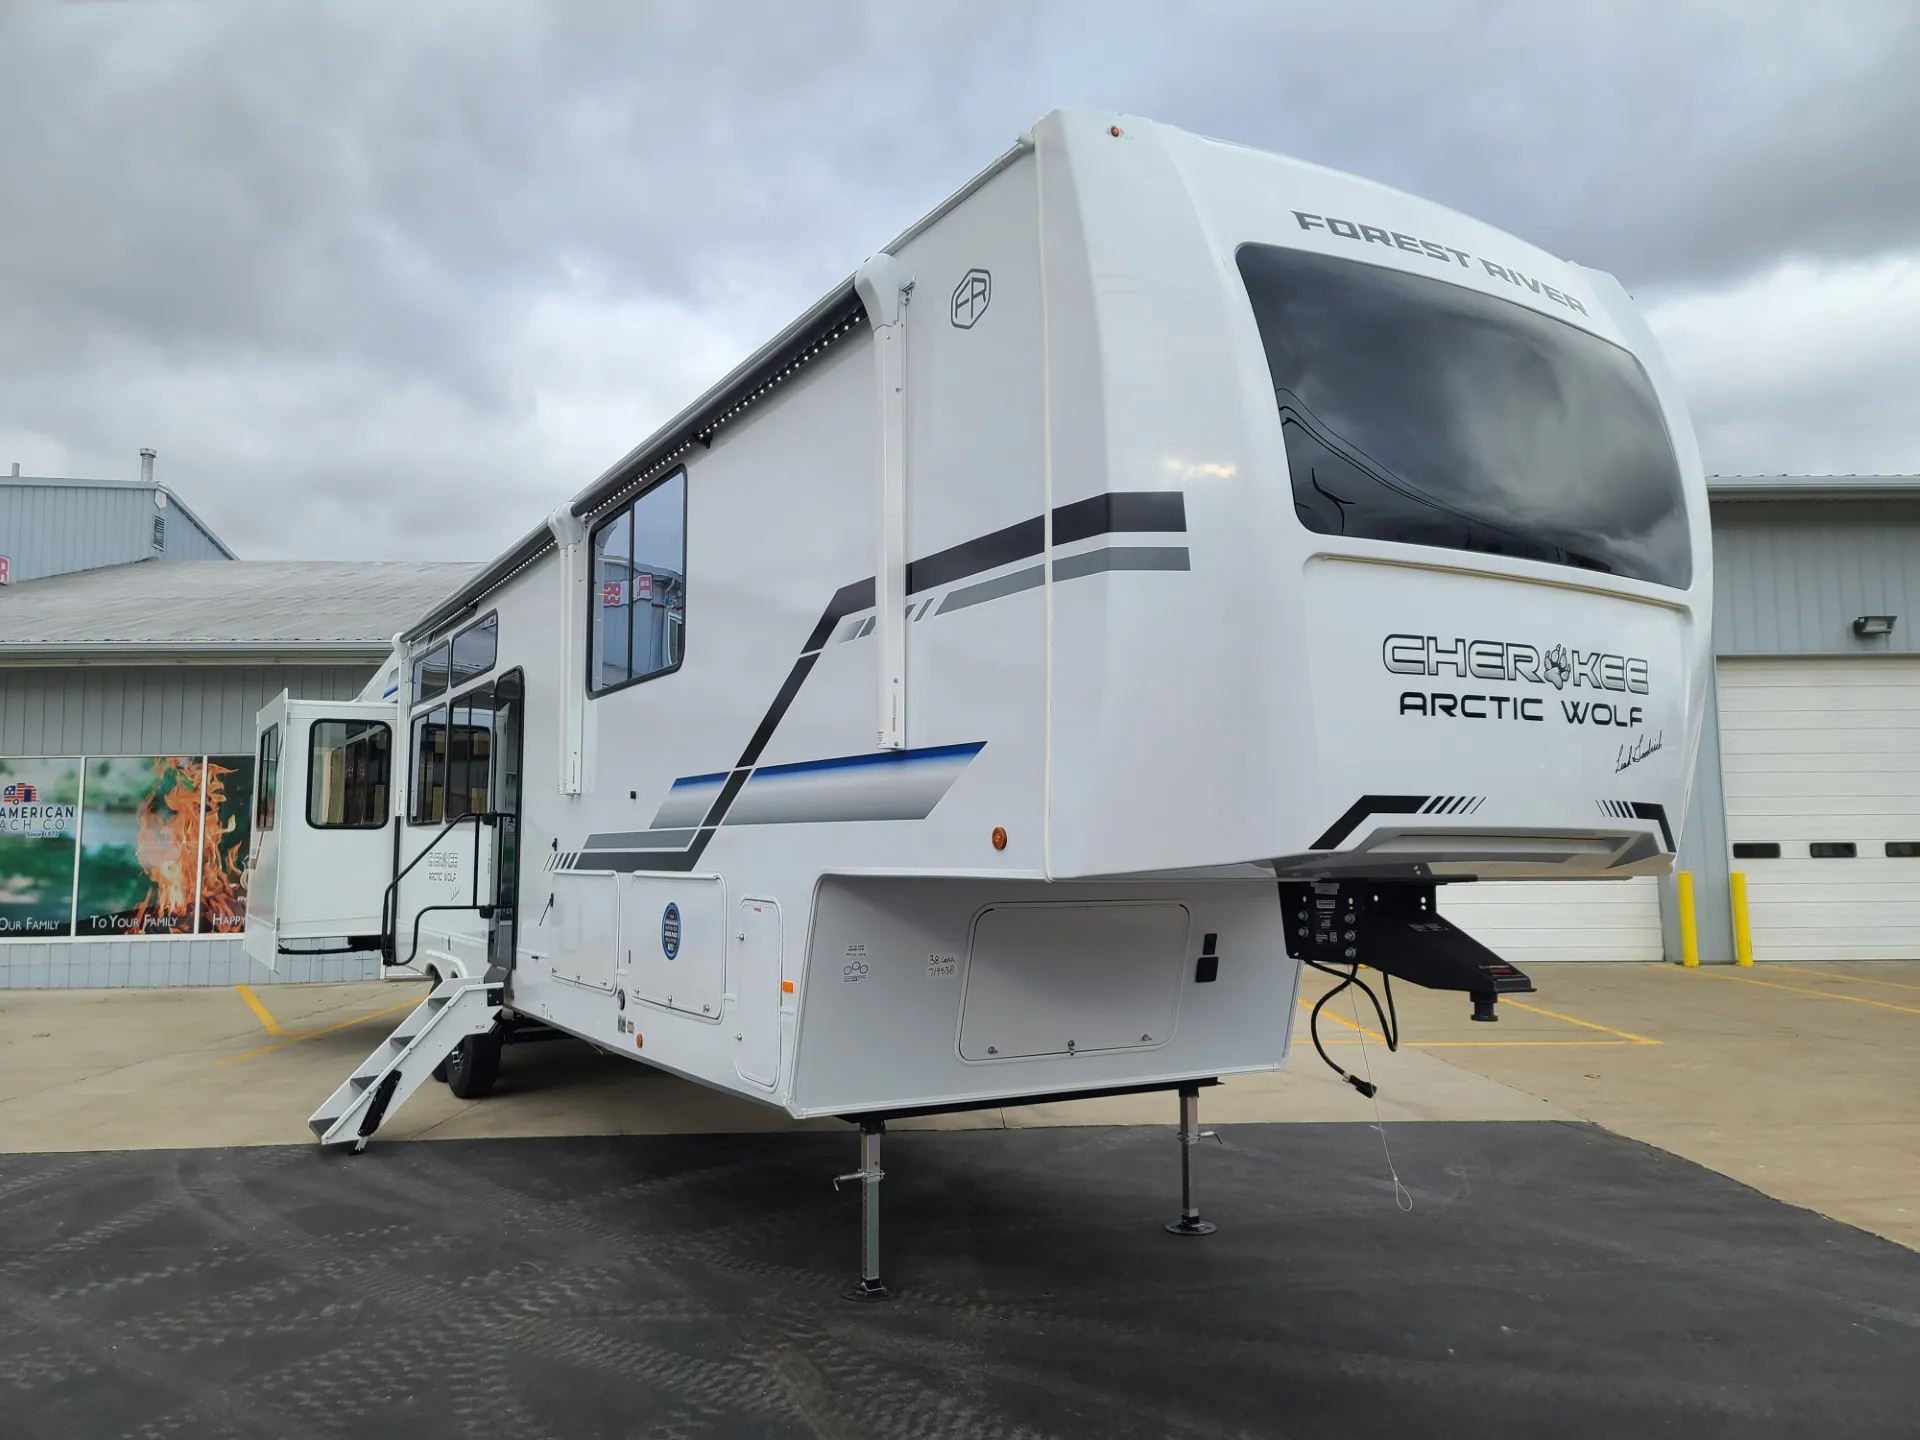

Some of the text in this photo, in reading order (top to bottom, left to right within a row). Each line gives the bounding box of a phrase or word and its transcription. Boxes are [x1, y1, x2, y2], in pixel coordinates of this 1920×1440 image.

[1290, 210, 1590, 318] FOREST RIVER
[1400, 692, 1643, 728] ARCTIC WOLF
[0, 806, 74, 818] AMERICAN
[43, 819, 67, 830] CO.
